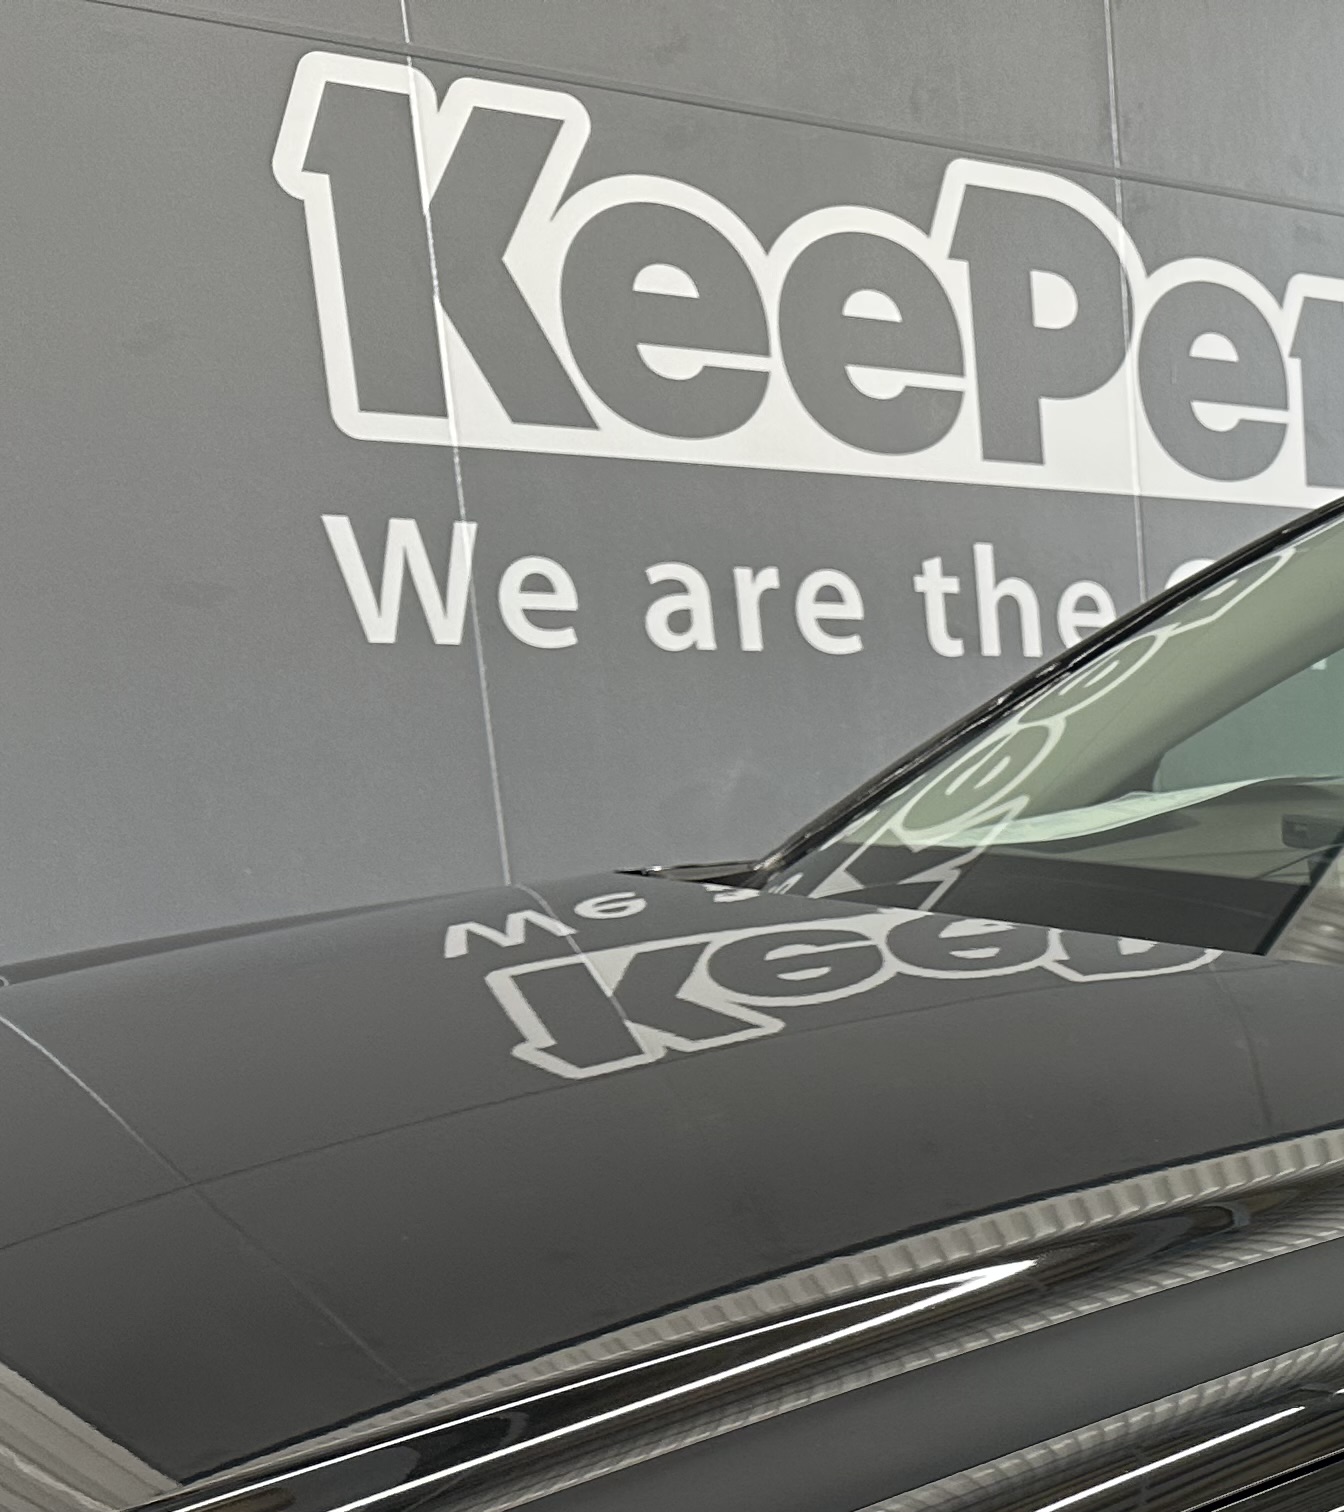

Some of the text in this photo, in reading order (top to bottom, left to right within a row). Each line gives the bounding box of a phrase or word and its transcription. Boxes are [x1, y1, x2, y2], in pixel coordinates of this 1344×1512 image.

[321, 514, 578, 649] We
[645, 560, 864, 655] are
[914, 542, 1116, 657] the
